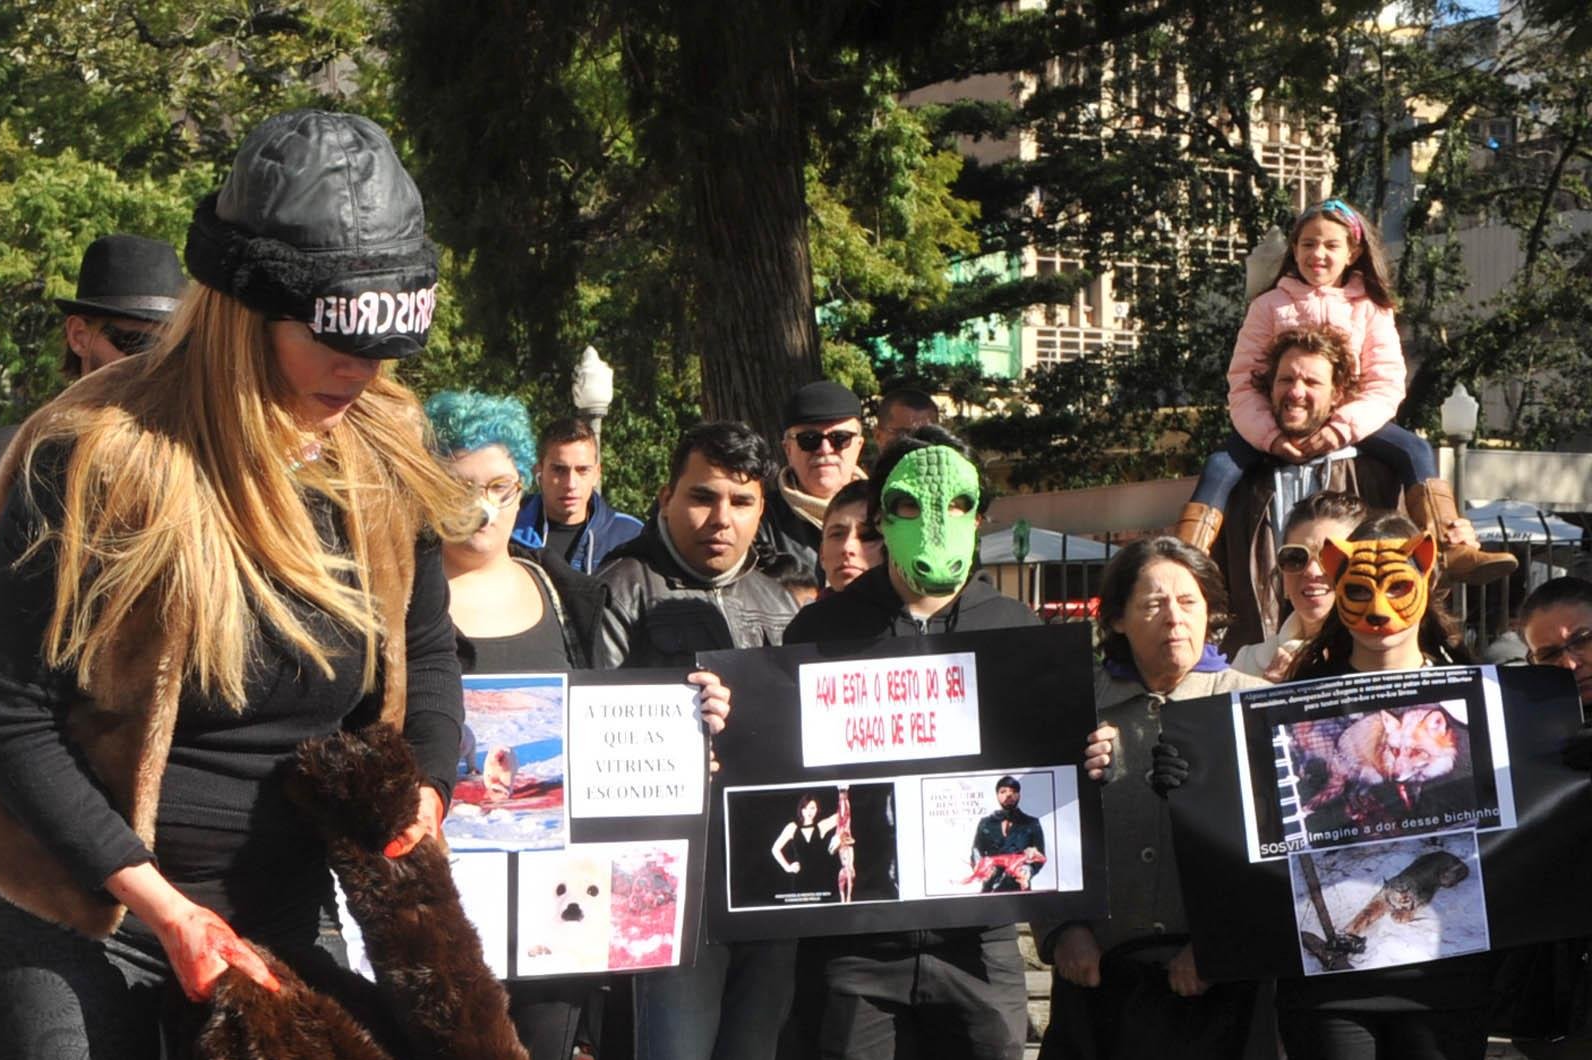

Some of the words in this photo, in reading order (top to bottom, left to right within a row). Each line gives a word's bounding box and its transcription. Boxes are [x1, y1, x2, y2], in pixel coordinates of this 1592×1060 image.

[816, 674, 837, 707] AQUI
[874, 672, 881, 702] O
[887, 668, 920, 702] RESTO
[926, 667, 939, 699] DO
[946, 665, 966, 699] SEU
[586, 704, 595, 719] A
[600, 703, 682, 718] TORTURA
[604, 730, 639, 748] QUE
[643, 730, 664, 744] AS
[845, 716, 885, 749] CASACO
[891, 713, 904, 744] DE
[910, 711, 937, 743] PELE
[596, 758, 675, 774] VITRINES
[585, 784, 684, 800] ESCONDEM!
[1308, 827, 1359, 842] Imagine
[1363, 826, 1371, 834] a
[1375, 822, 1396, 832] dor
[1401, 816, 1440, 829] desse
[1444, 807, 1501, 823] bichinho
